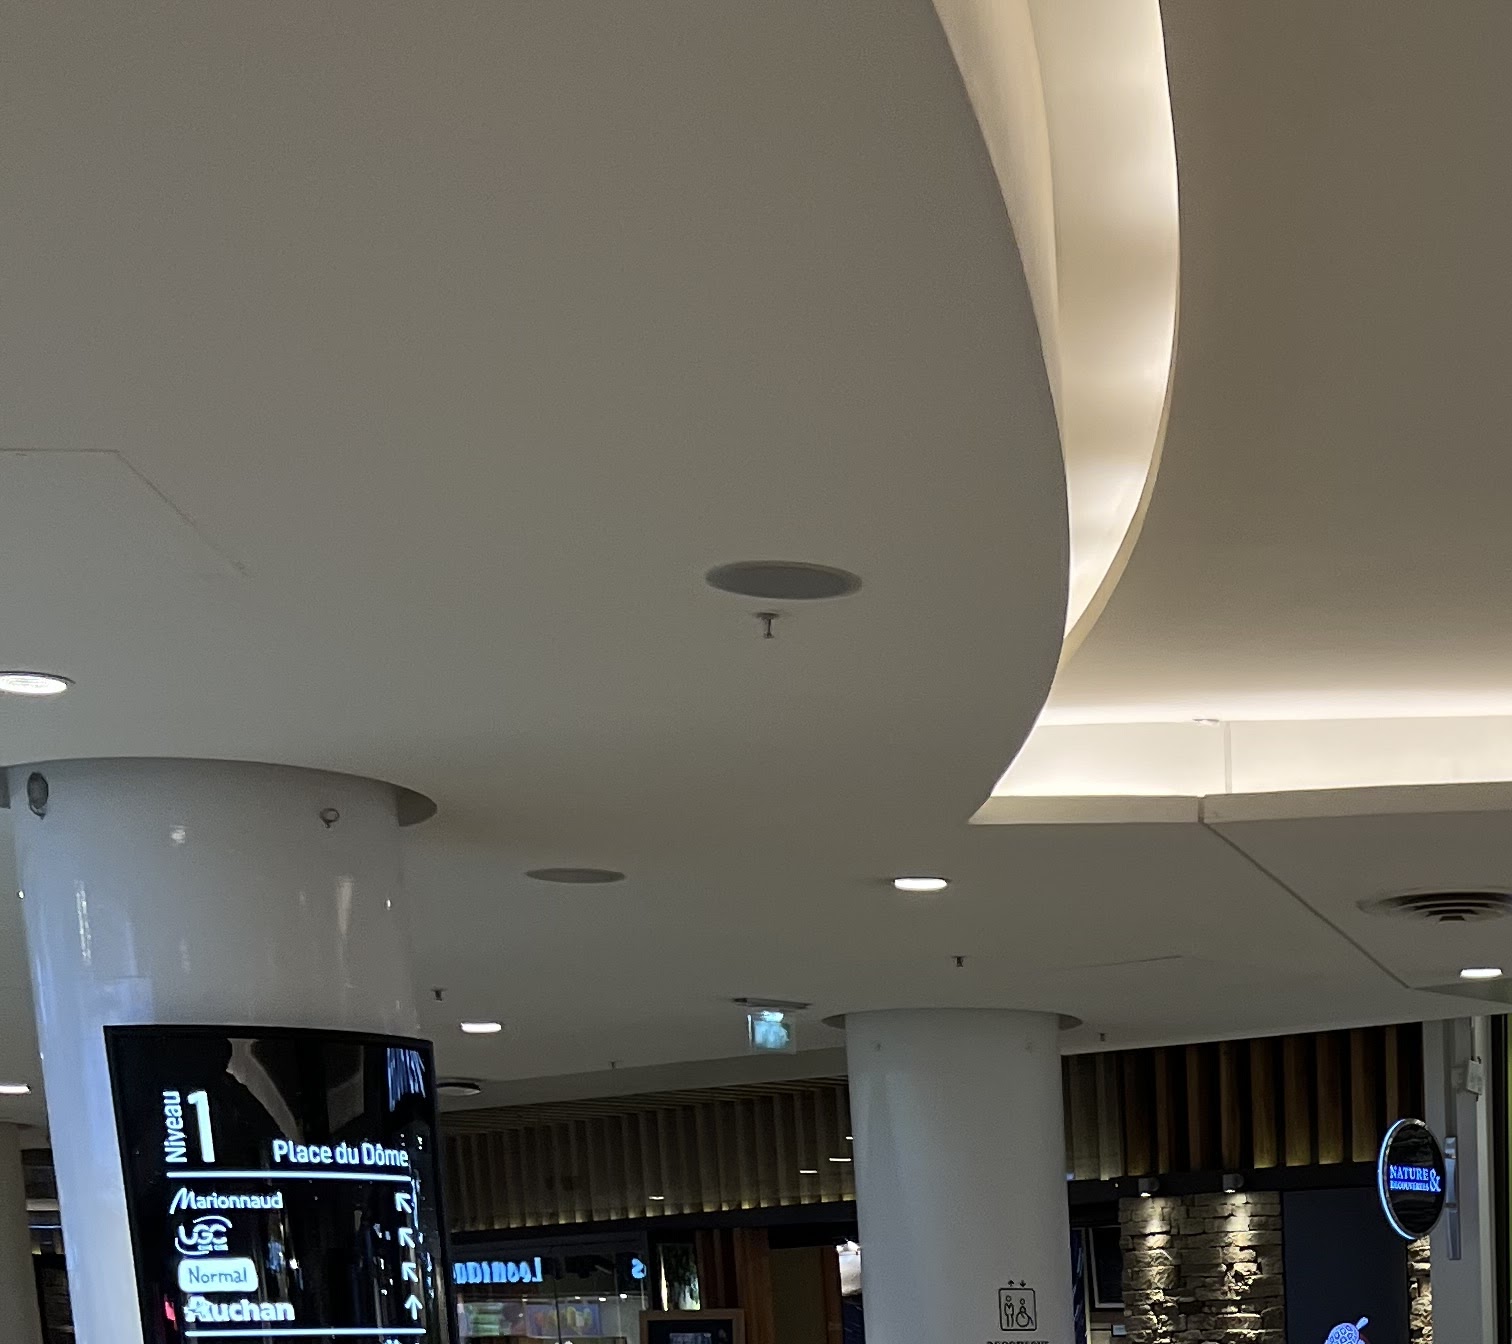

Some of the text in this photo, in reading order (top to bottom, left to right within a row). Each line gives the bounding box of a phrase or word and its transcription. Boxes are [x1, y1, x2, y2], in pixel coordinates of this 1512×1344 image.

[163, 1090, 188, 1164] Niveau
[187, 1089, 216, 1163] 1
[272, 1138, 409, 1167] Place du Dôme
[1389, 1165, 1429, 1181] NATURE
[169, 1187, 284, 1214] Marionnaud
[178, 1223, 228, 1246] UGC
[188, 1266, 248, 1284] Normal
[184, 1295, 296, 1323] Auchan
